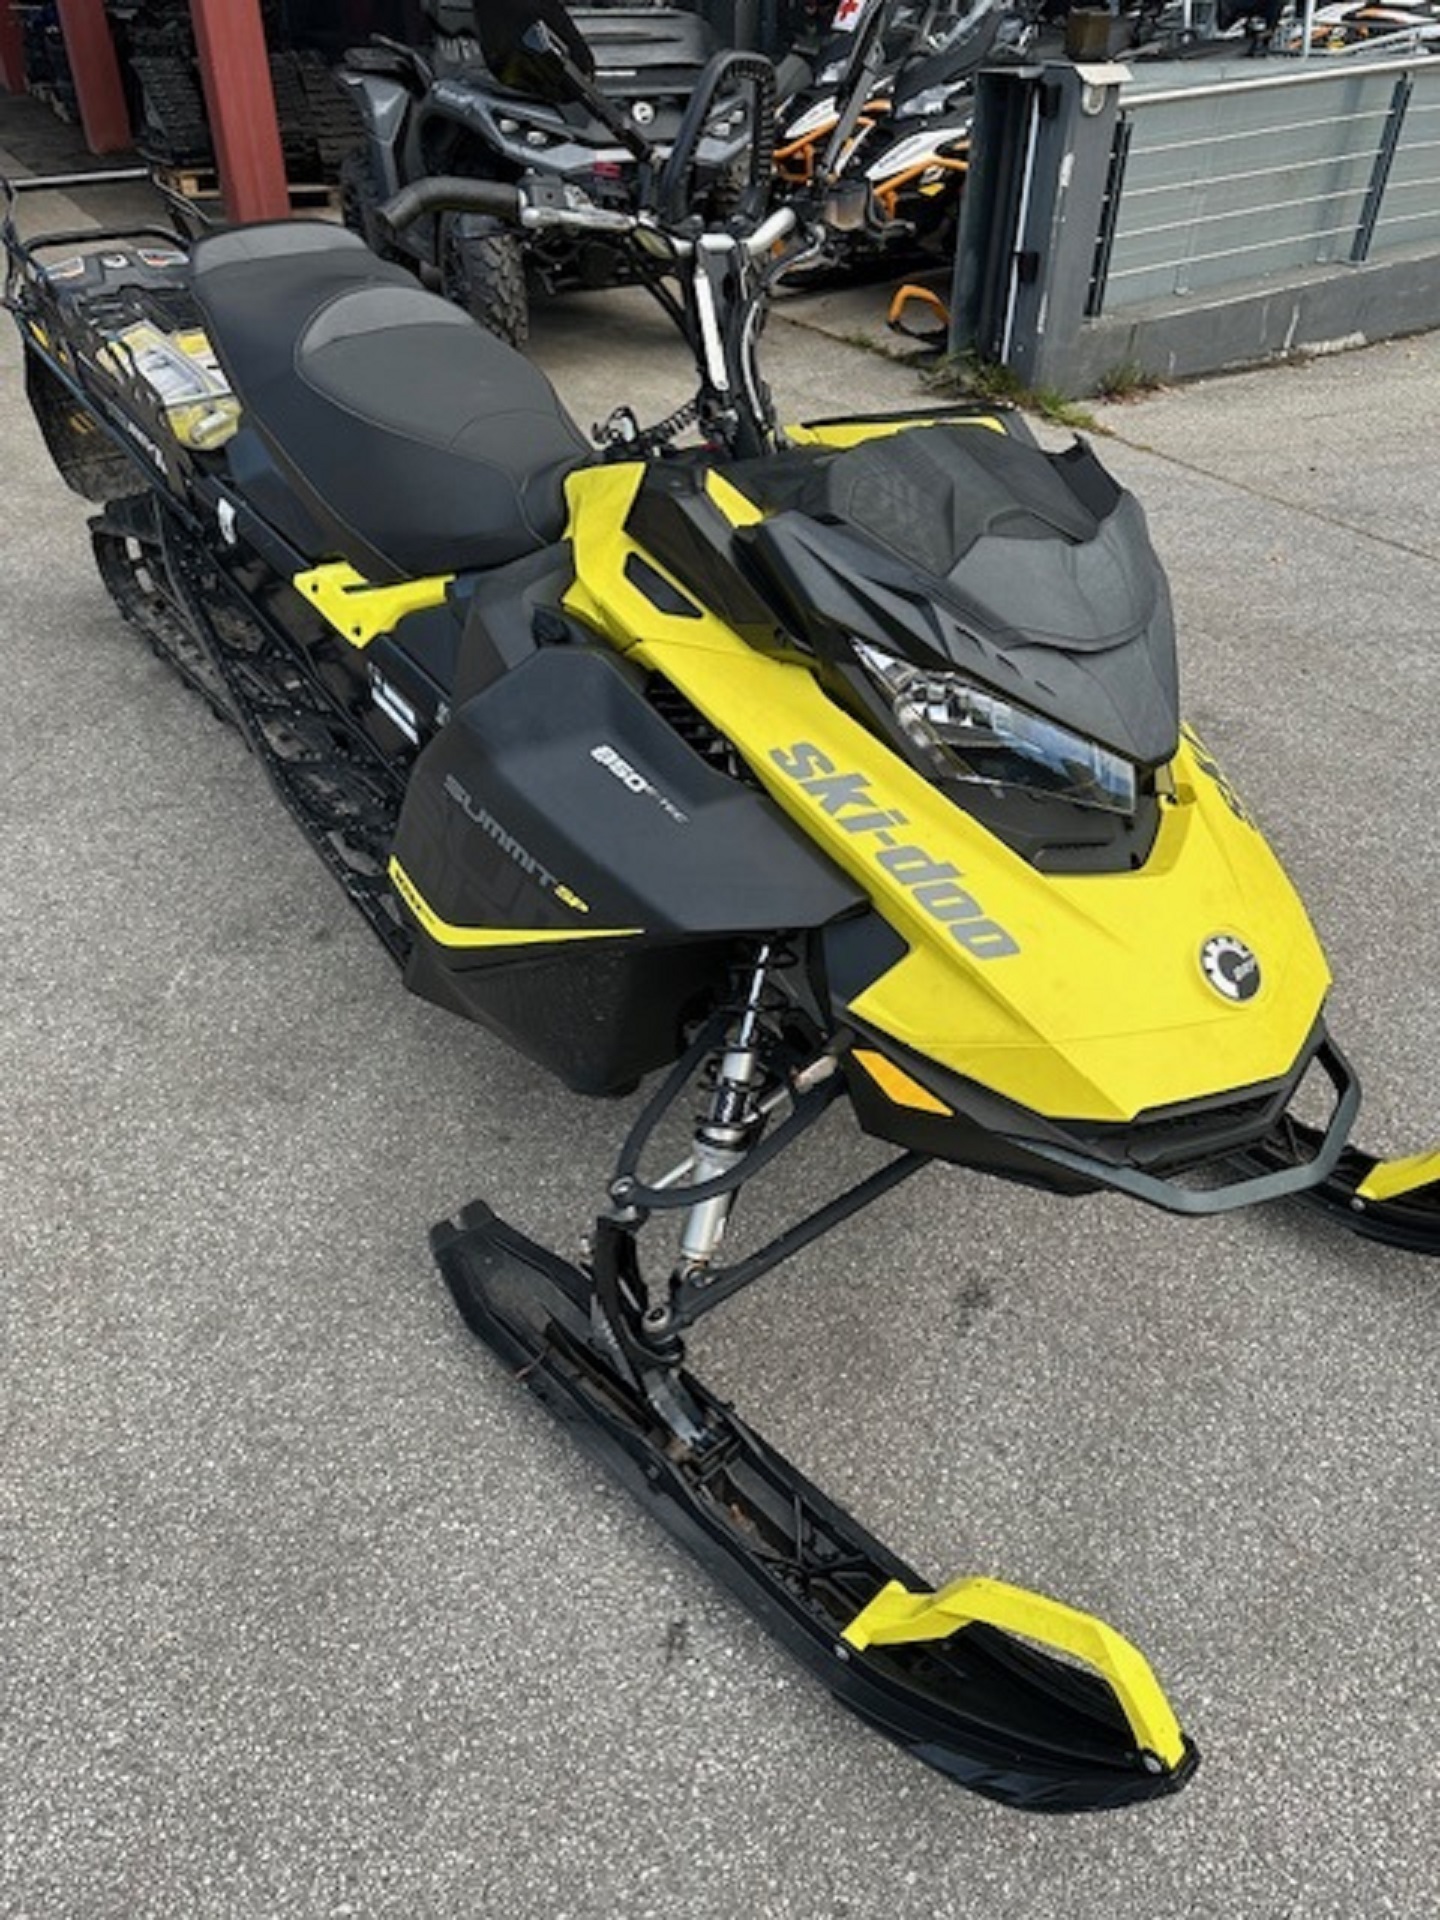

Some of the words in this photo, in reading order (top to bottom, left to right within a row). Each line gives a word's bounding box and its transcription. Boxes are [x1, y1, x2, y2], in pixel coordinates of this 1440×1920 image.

[590, 744, 647, 792] 850
[443, 773, 558, 887] SUMMIT
[769, 741, 1021, 960] ski-doo
